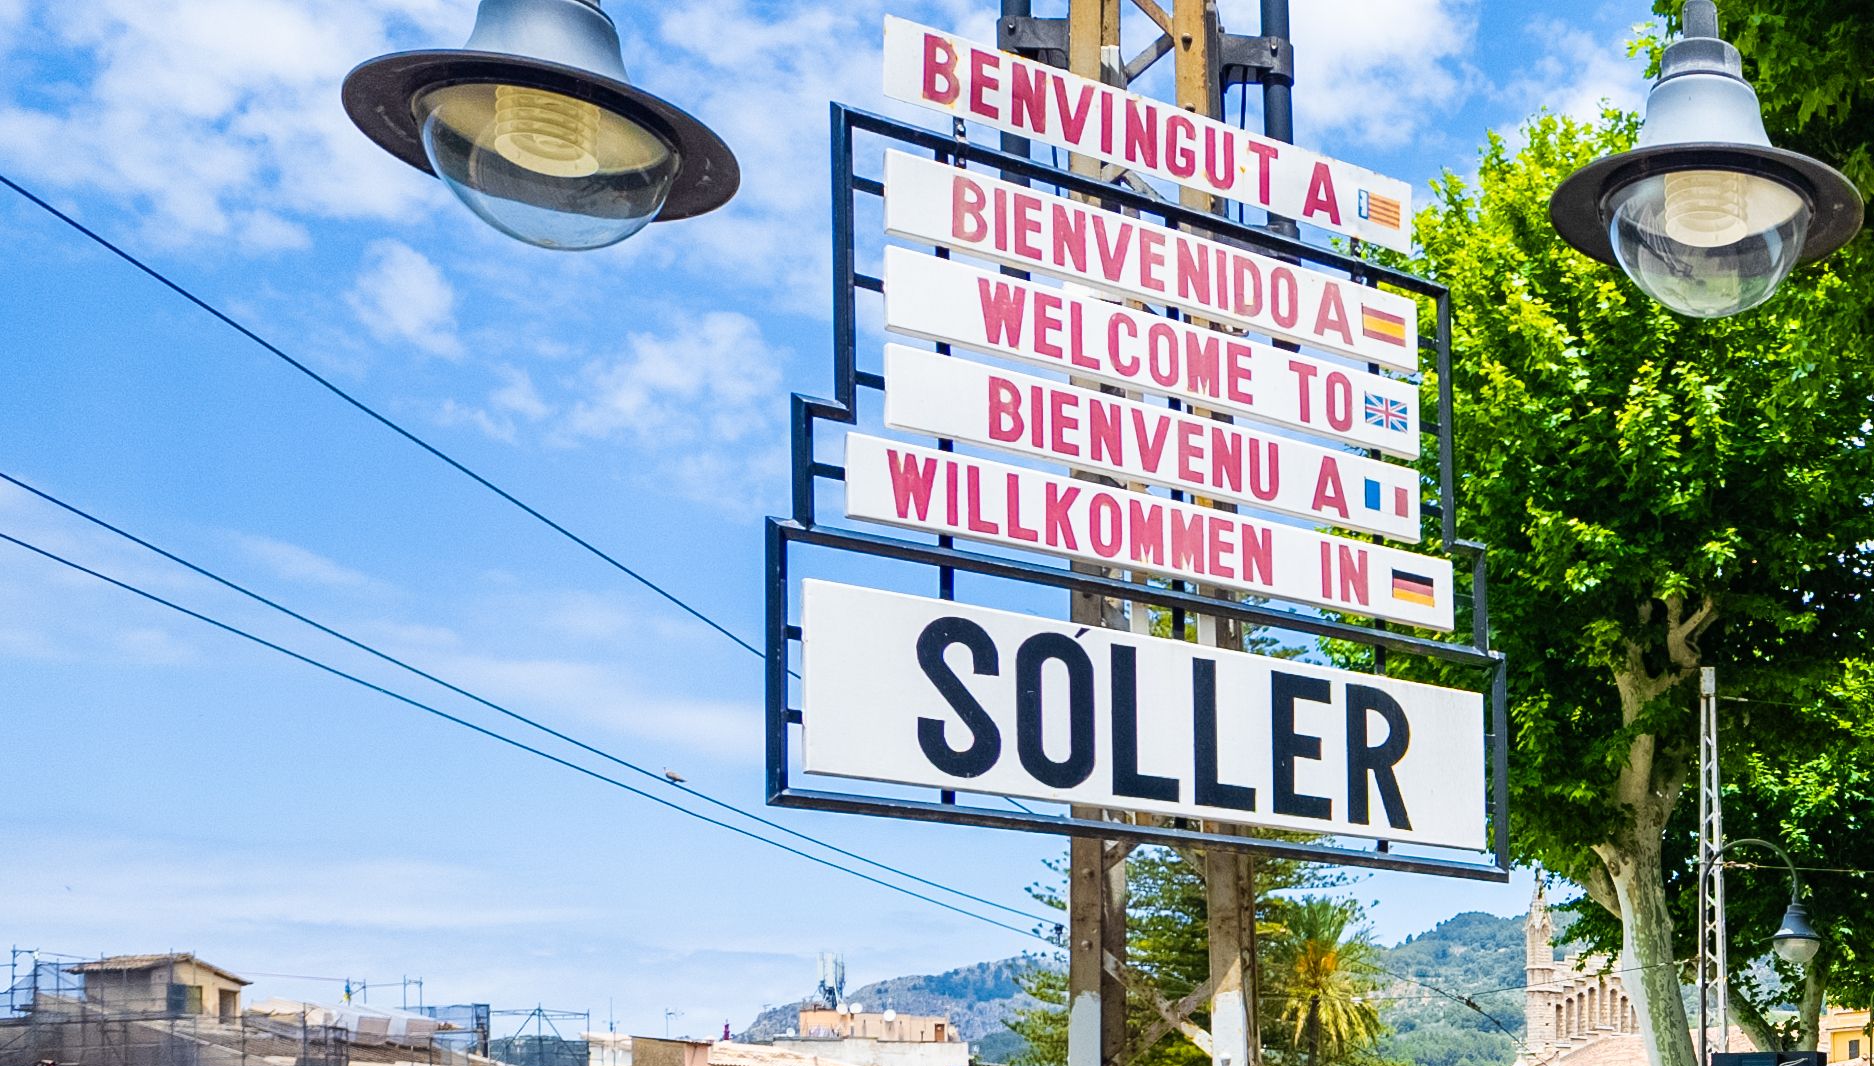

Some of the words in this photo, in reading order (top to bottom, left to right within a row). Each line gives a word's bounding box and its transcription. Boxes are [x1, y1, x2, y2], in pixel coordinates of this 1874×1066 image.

[923, 35, 1279, 204] BENVINGUT
[1303, 162, 1341, 225] A
[952, 176, 1298, 328] BIENVENIDO
[1315, 283, 1353, 345] A
[979, 277, 1254, 404] WELCOME
[1289, 360, 1353, 432] TO
[887, 449, 1273, 586] WILLKOMMEN
[1321, 541, 1369, 606] IN
[989, 376, 1280, 501] BIENVENU
[1312, 456, 1349, 519] A
[917, 617, 1413, 831] SÓLLER
